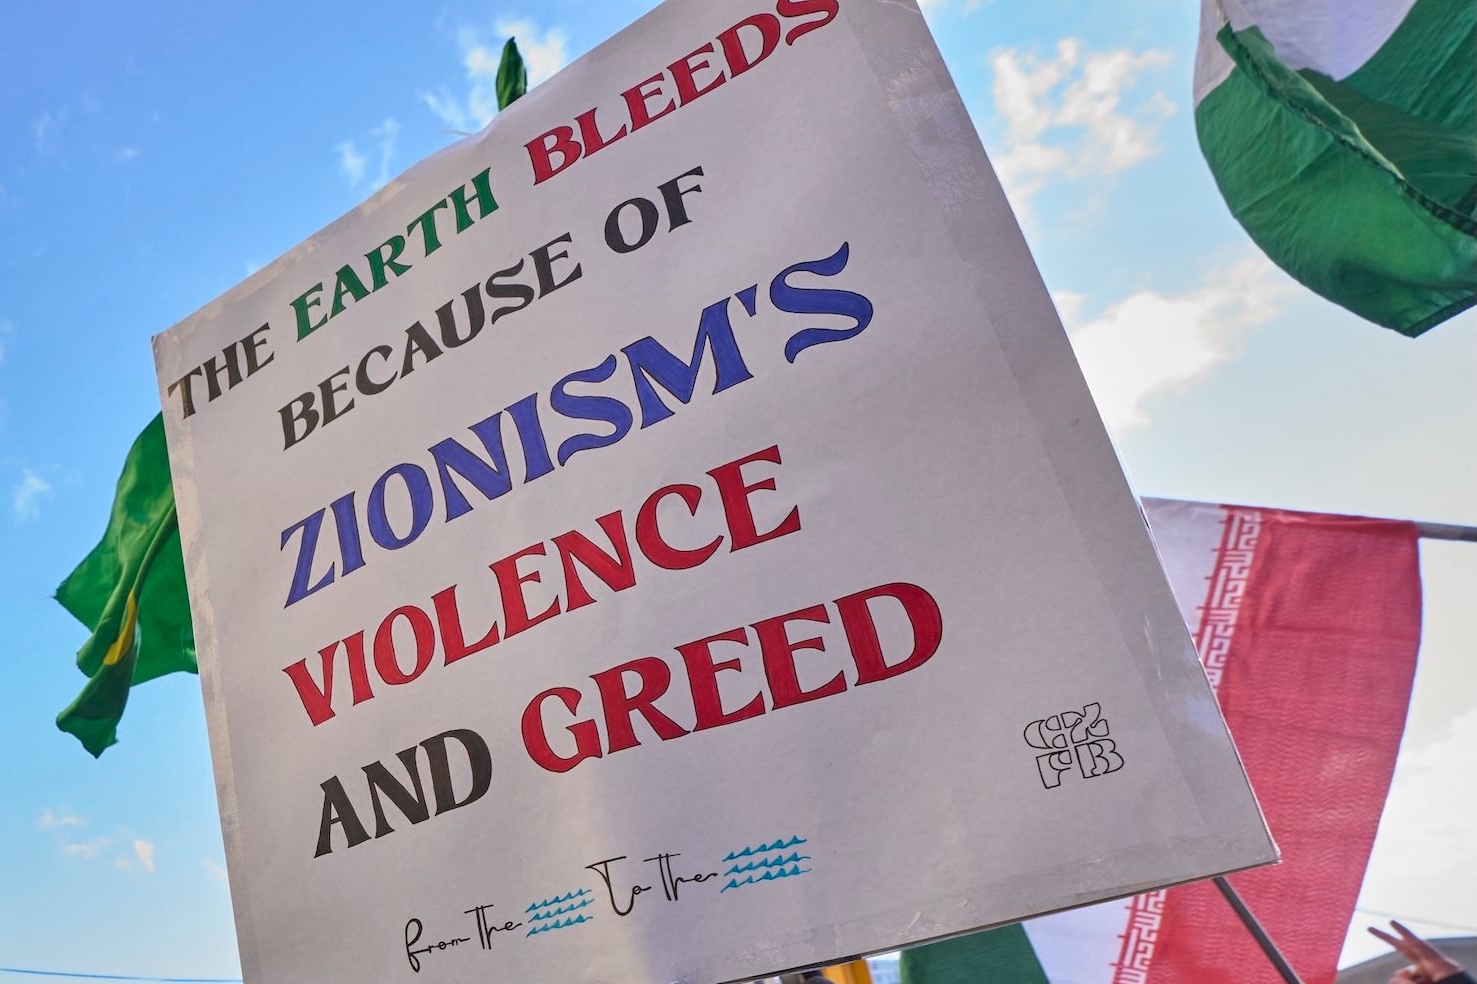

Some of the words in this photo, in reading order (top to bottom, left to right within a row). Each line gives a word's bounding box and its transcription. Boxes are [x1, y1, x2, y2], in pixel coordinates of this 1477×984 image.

[167, 323, 275, 420] THE
[289, 167, 500, 342] EARTH
[523, 0, 840, 186] BLEEDS
[278, 232, 584, 451] BECAUSE
[603, 165, 705, 256] OF
[280, 241, 875, 609] ZIONISM'S
[281, 444, 802, 727] VIOLENCE
[313, 727, 494, 859] AND
[520, 581, 944, 774] GREED
